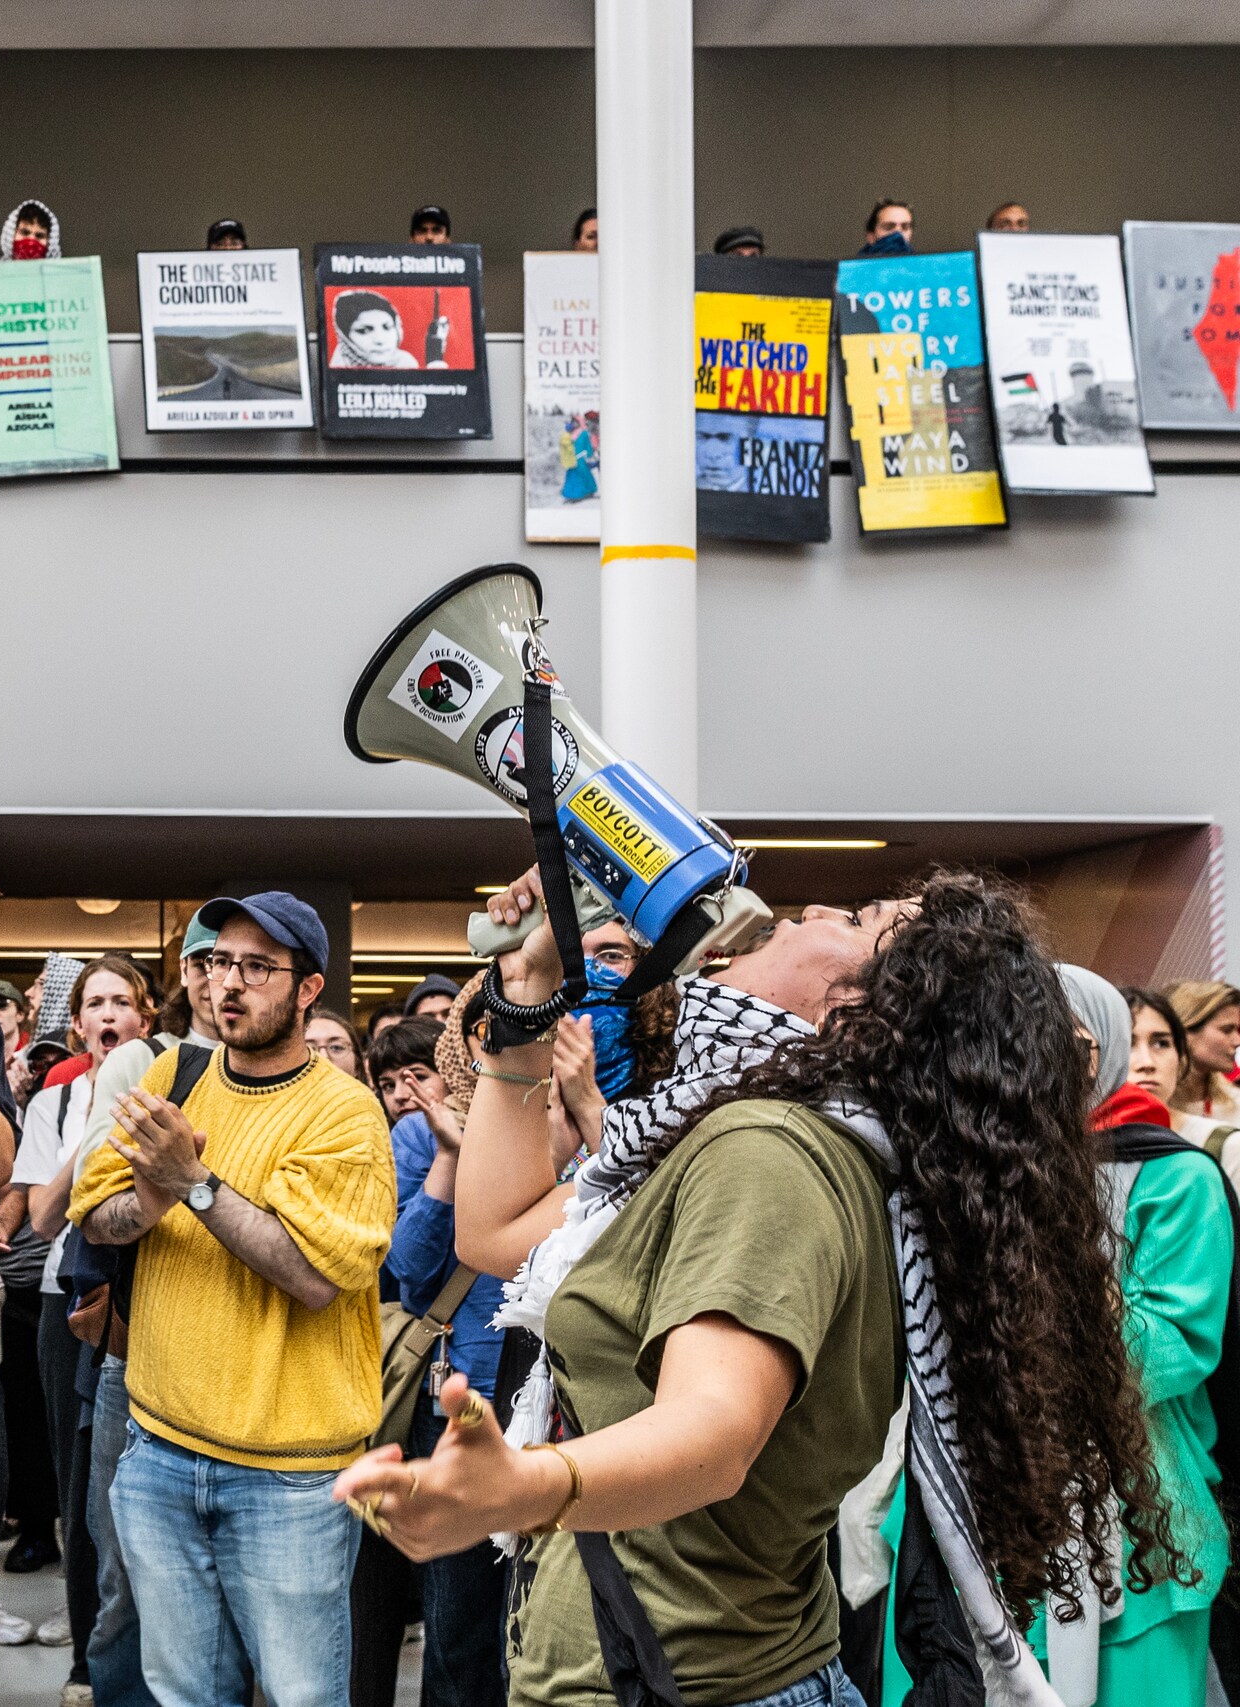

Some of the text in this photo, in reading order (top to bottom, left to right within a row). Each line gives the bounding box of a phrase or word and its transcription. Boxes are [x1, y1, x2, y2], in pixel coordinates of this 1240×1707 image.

[158, 262, 277, 283] THE ONE-STATE
[331, 255, 466, 274] My People Shall Live
[159, 284, 248, 305] CONDITION
[847, 286, 971, 313] TOWERS
[1007, 282, 1099, 302] SANCTIONS
[1009, 304, 1101, 319] AGAINST ISRAEL
[742, 322, 765, 340] THE
[891, 312, 929, 333] OF
[538, 341, 600, 355] CLEAN
[701, 338, 808, 372] WRETCHED
[868, 334, 959, 358] IVORY
[698, 367, 713, 382] OF
[885, 359, 948, 380] AND
[338, 393, 427, 410] LEILA KHALED
[719, 366, 822, 416] EARTH
[877, 383, 960, 407] STEEL
[8, 402, 53, 411] ARIELLA
[167, 410, 199, 421] ARIELLA
[203, 411, 238, 421] AZOULAY
[242, 411, 249, 420] &
[6, 422, 55, 432] AZOULAY
[884, 430, 966, 453] MAYA
[739, 438, 824, 469] FRANTZ
[884, 453, 969, 475] WIND
[748, 465, 820, 498] FANON
[429, 648, 483, 690] FREE PALESTINE
[407, 677, 466, 724] END THE OCCUPATION!
[476, 733, 487, 754] EAT
[582, 786, 662, 859] BOYCOTT
[613, 837, 648, 869] GENOCIDE
